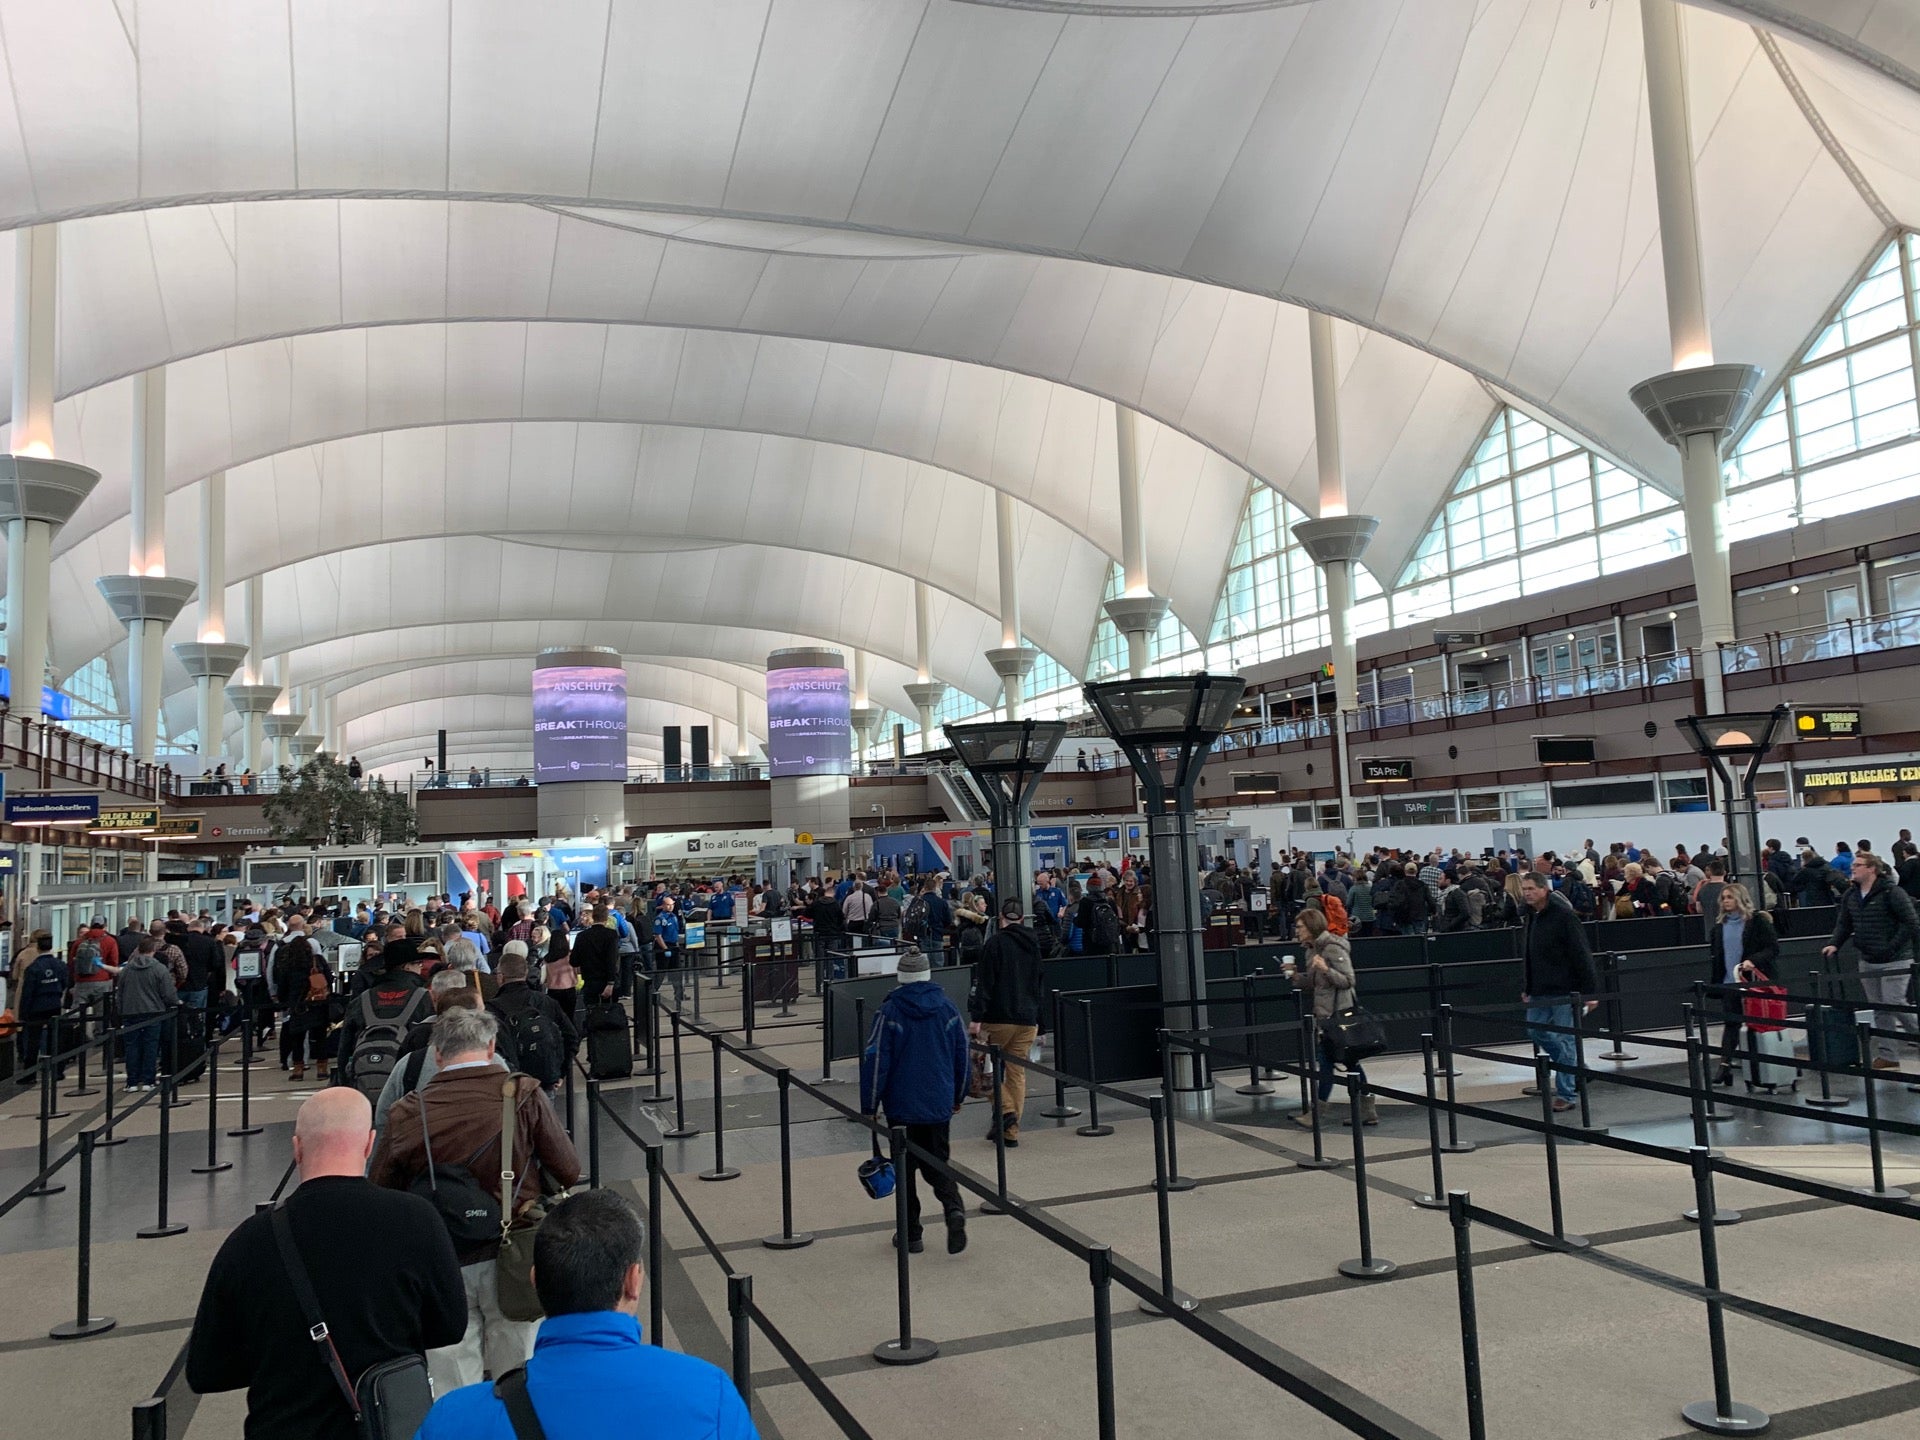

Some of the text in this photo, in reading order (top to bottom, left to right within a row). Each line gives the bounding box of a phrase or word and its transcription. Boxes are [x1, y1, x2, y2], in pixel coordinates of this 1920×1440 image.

[553, 681, 614, 692] ANSCHUTZ
[788, 681, 841, 691] ANSCHUTZ
[769, 717, 850, 728] BREAKTHROUG
[1368, 767, 1384, 776] TSA
[1804, 767, 1920, 787] AIRPORT BAGGAGE CEN
[1404, 803, 1417, 812] TSA
[116, 819, 144, 827] HOUSE
[1029, 834, 1058, 842] outhwest
[704, 839, 758, 849] to all Gates
[465, 1209, 488, 1218] SMITH
